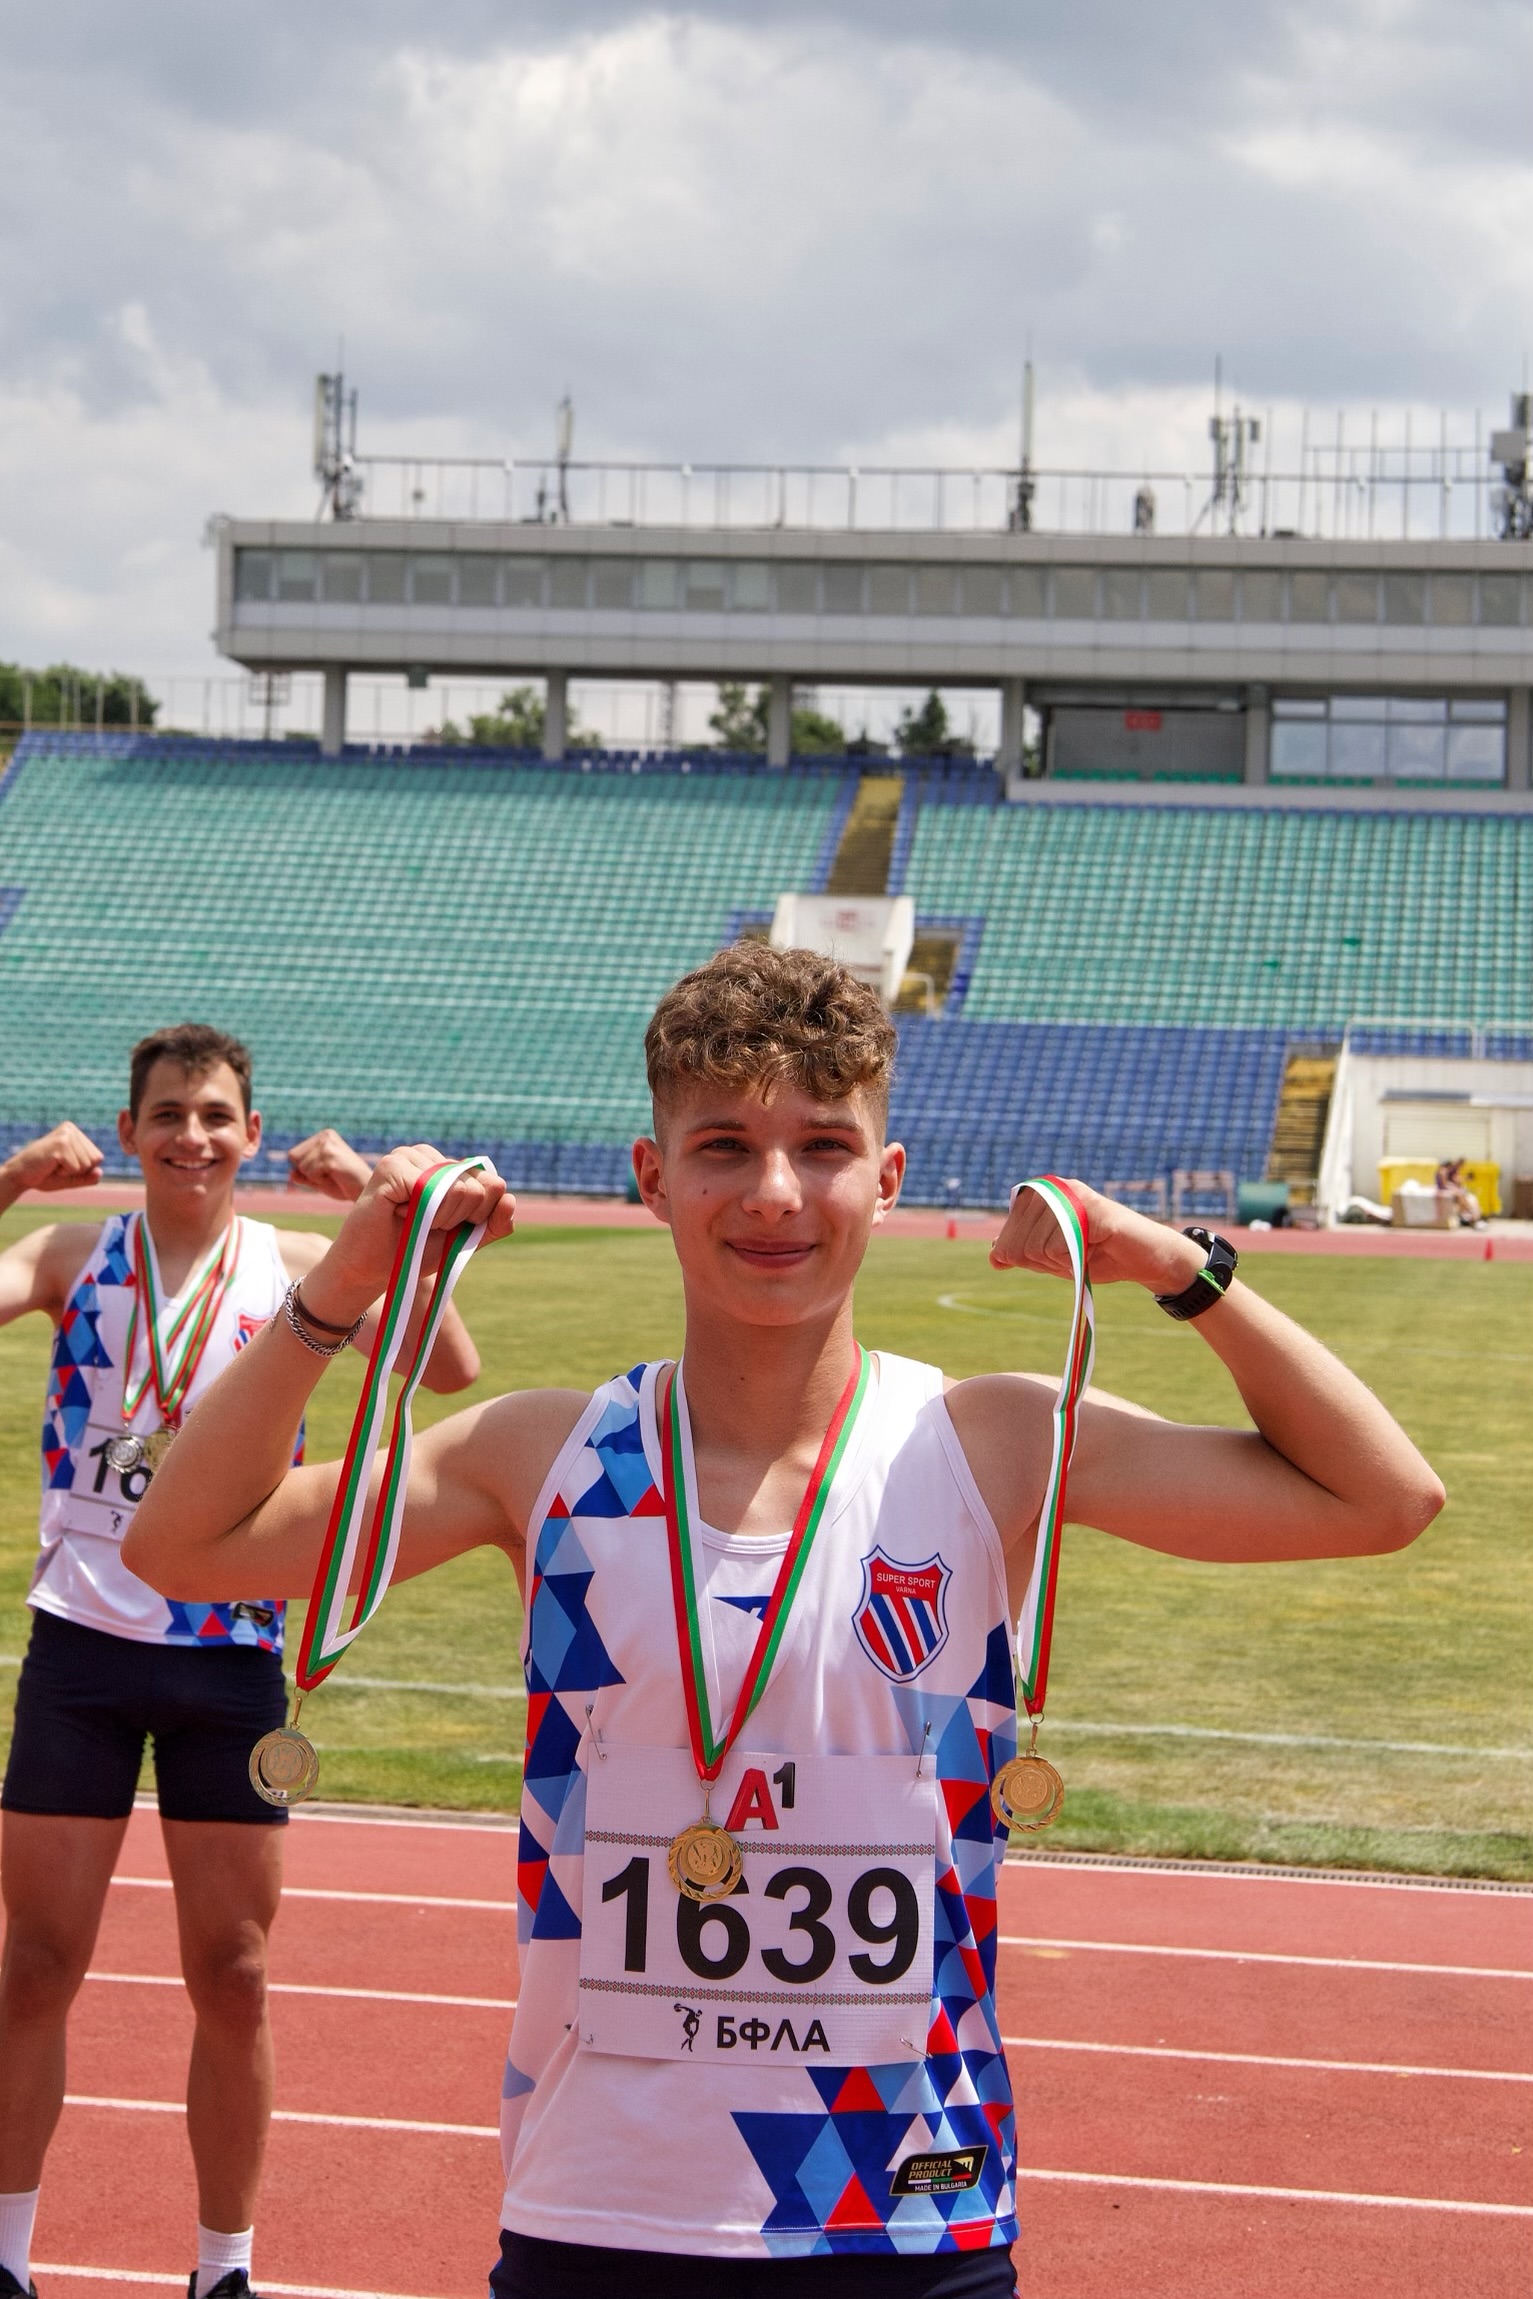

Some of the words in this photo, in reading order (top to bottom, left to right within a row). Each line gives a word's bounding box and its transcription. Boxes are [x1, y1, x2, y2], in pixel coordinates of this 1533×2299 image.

[876, 1573, 906, 1584] SUPER
[907, 1577, 936, 1588] SPORT
[895, 1586, 916, 1594] VARNA
[601, 1856, 920, 1985] 1639
[716, 2015, 831, 2052] БФЛА
[911, 2160, 952, 2170] OFFICIAL
[909, 2168, 952, 2179] PRODUCT
[932, 2183, 940, 2191] IN
[940, 2181, 967, 2190] BULGARIA
